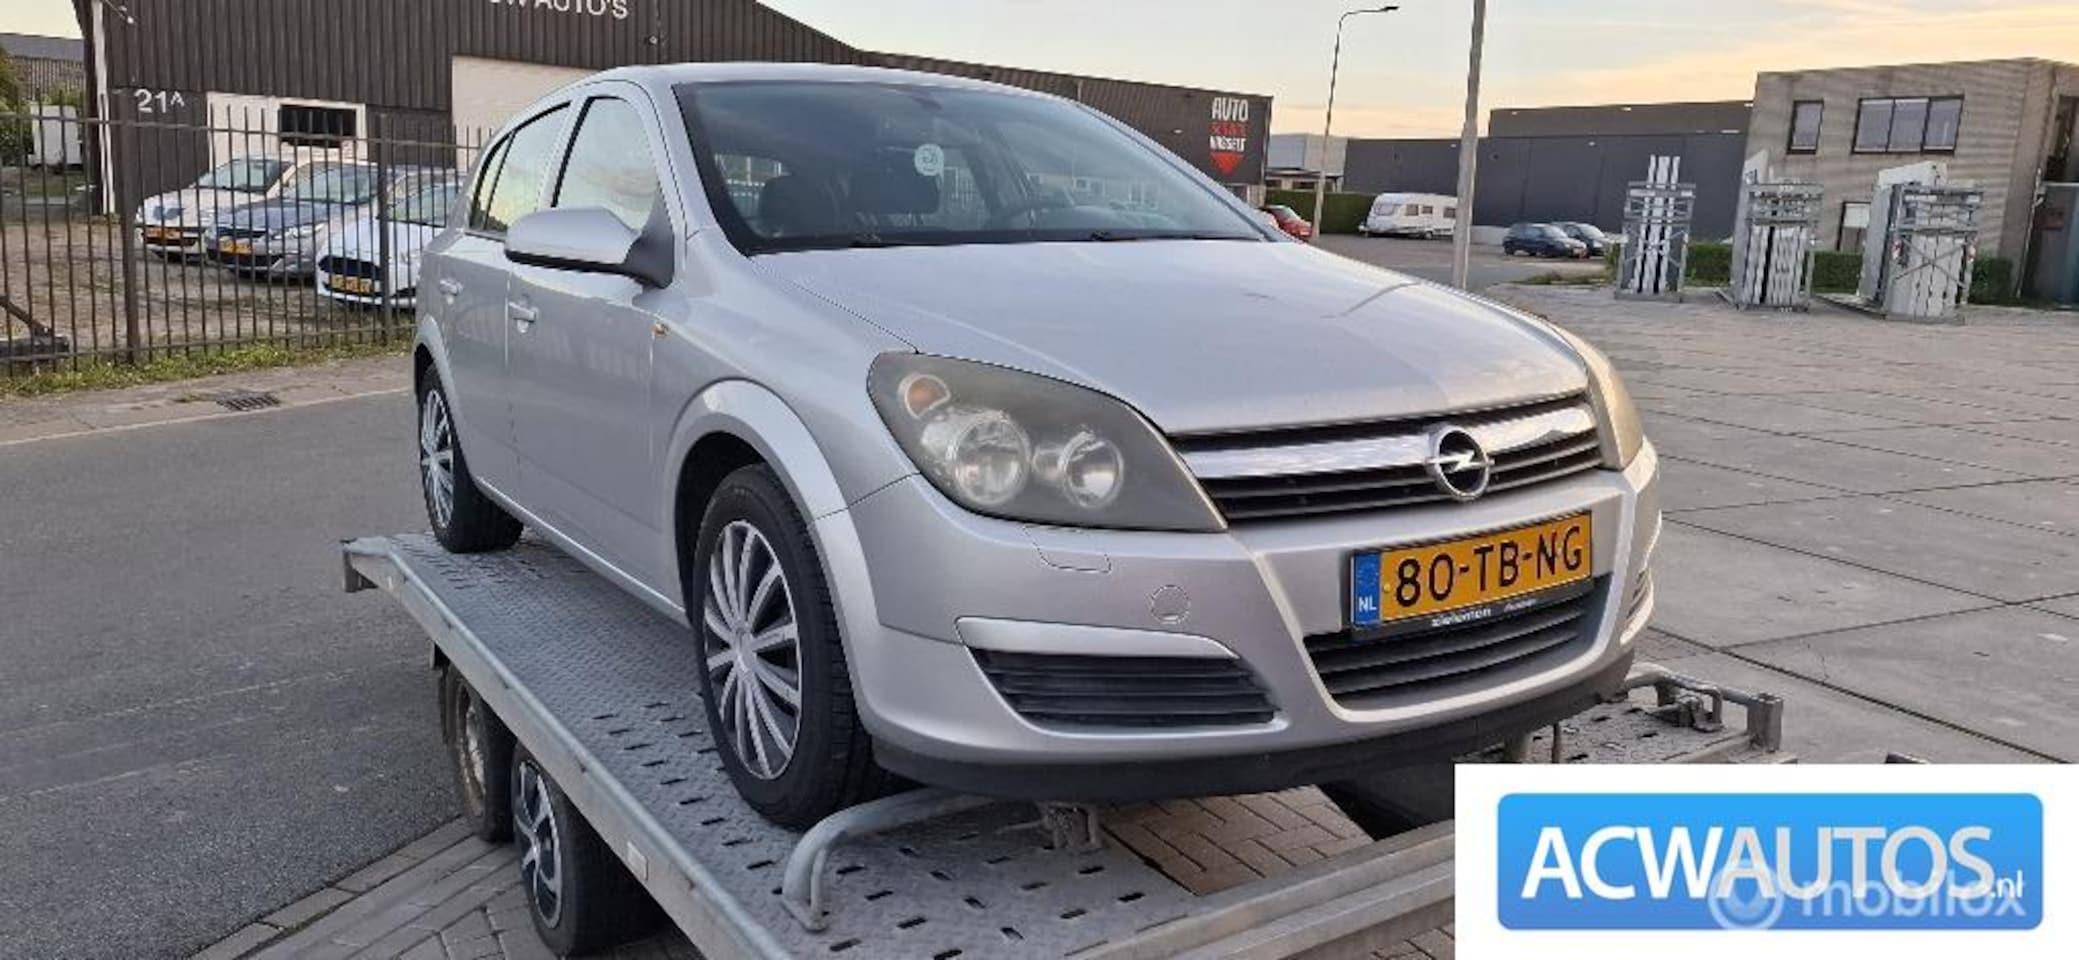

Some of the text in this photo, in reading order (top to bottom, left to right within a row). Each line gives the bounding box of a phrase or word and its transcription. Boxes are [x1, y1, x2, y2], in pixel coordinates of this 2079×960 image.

[1211, 97, 1249, 122] AUTO
[1396, 525, 1583, 607] 80-TB-NG
[1358, 596, 1378, 612] NL
